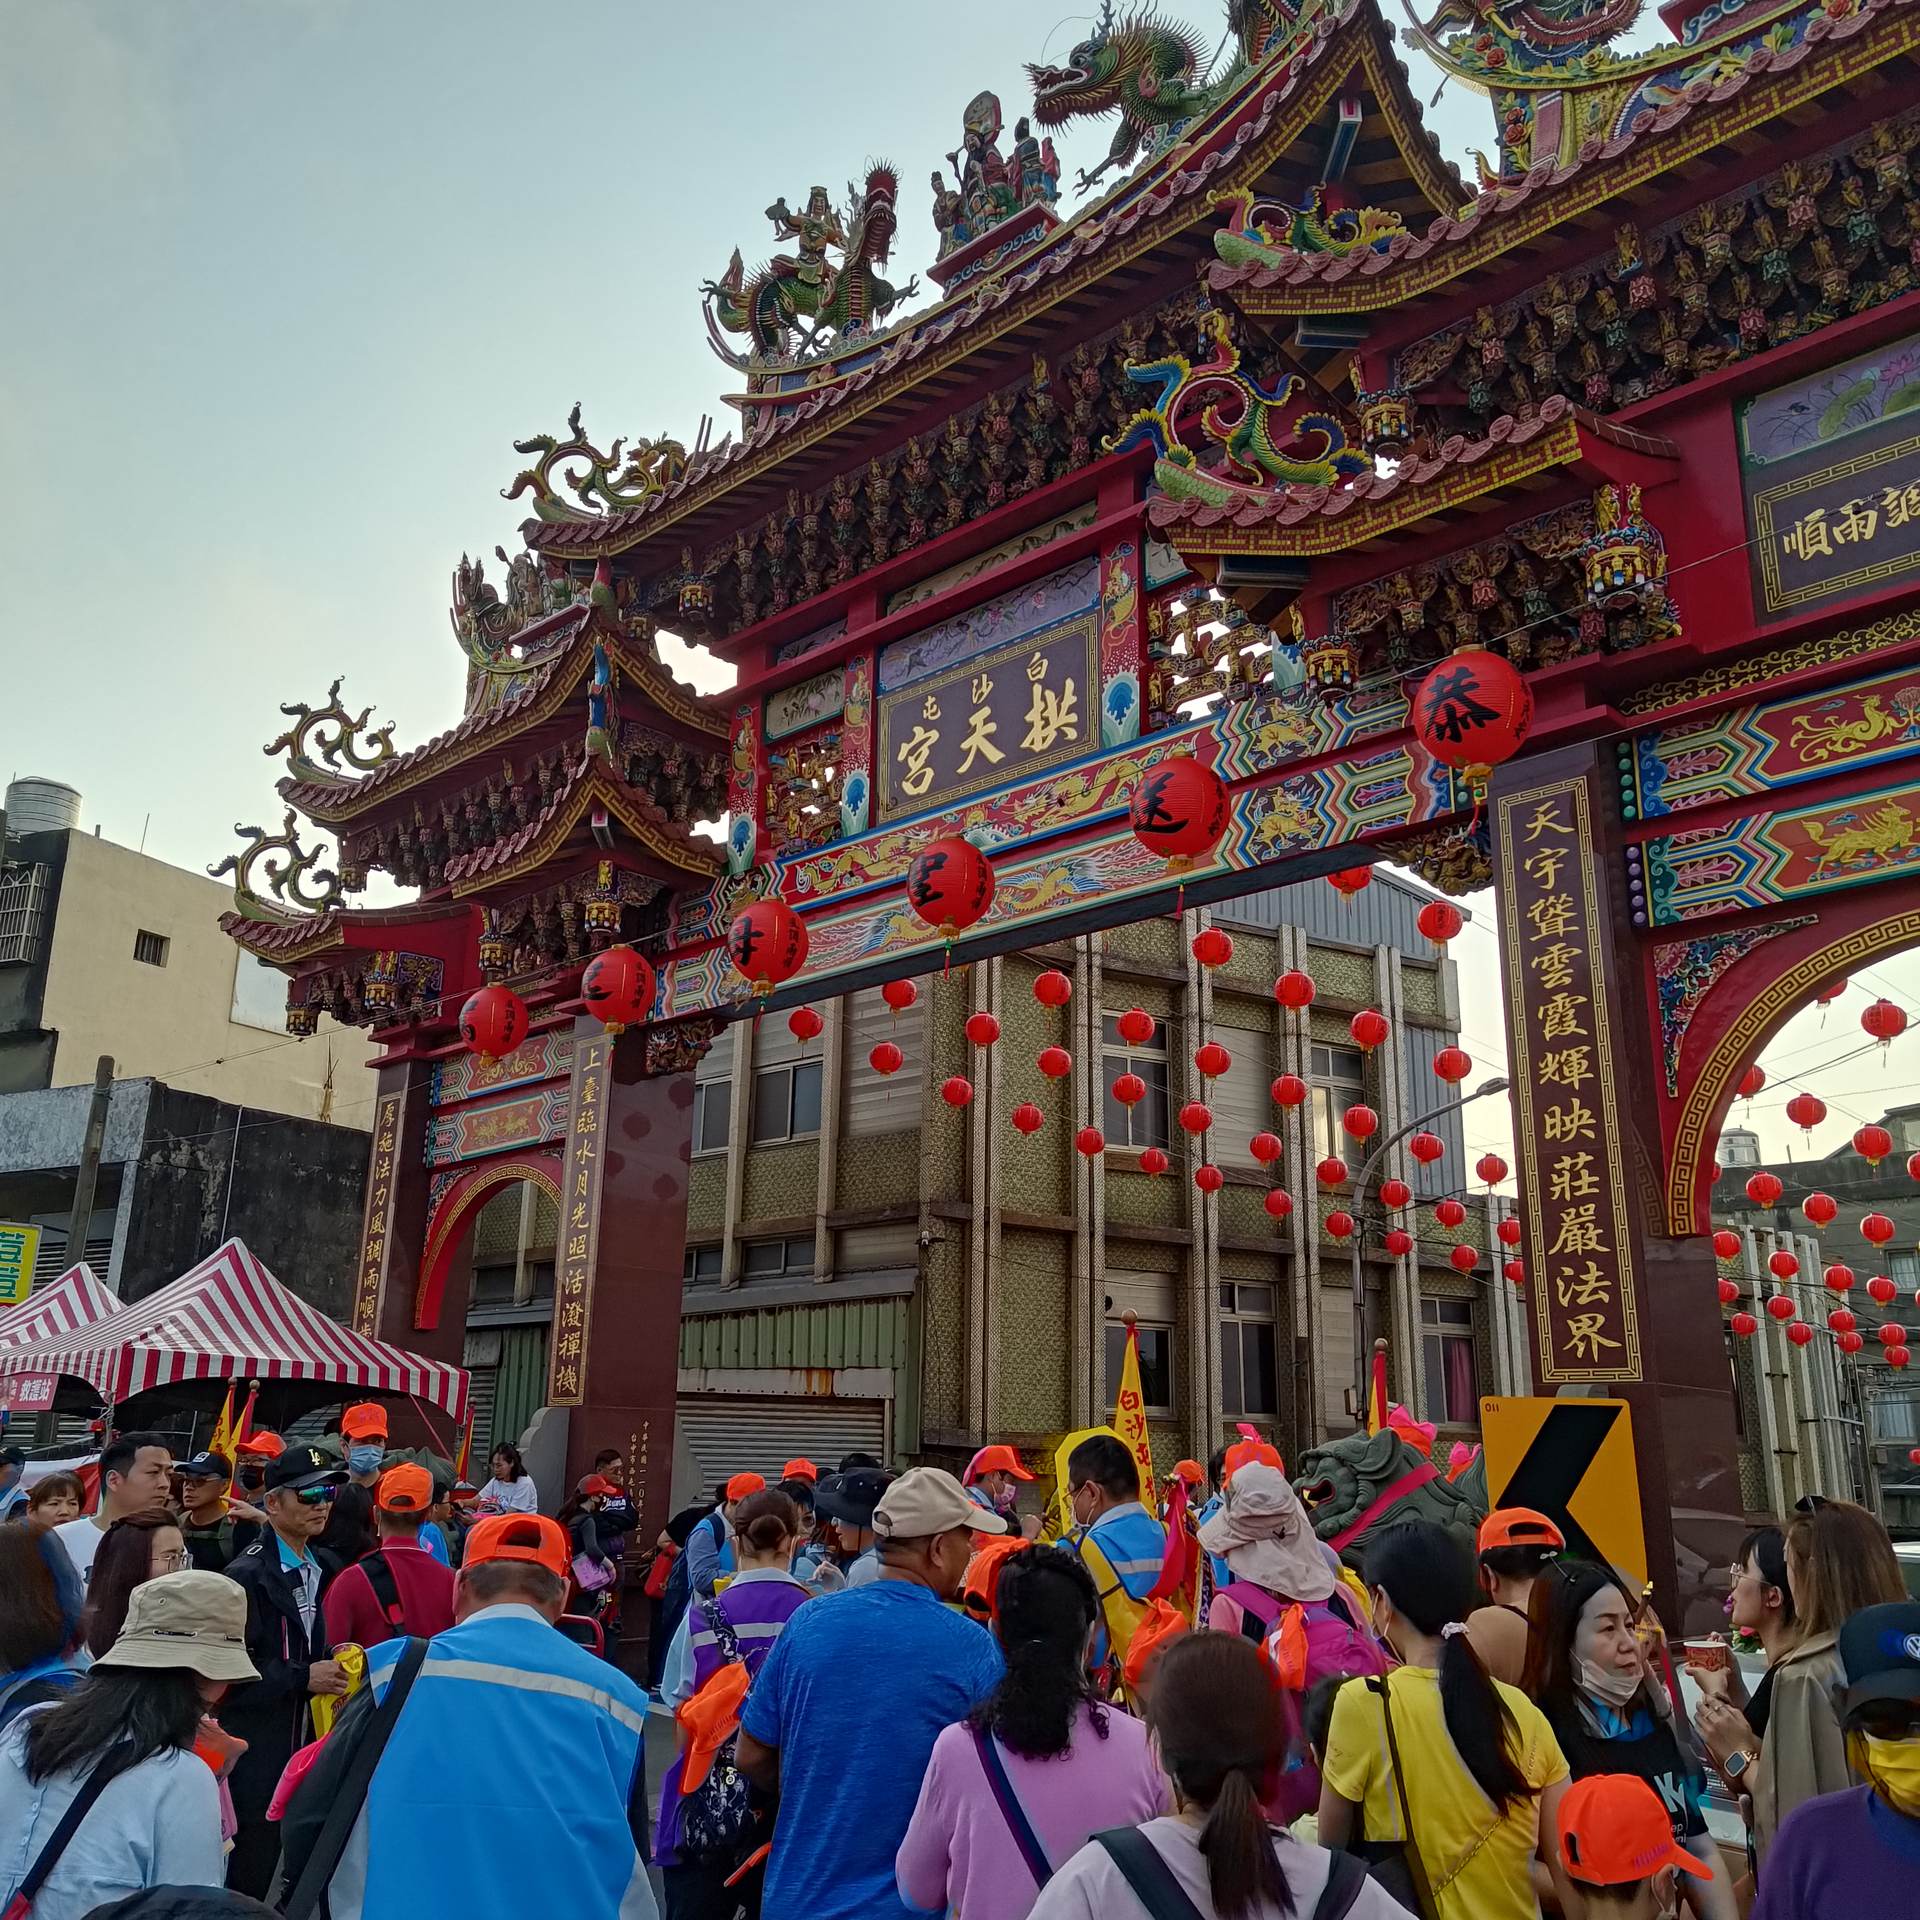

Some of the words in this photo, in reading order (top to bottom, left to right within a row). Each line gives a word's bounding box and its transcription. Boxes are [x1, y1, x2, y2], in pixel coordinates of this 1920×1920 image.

[897, 677, 1079, 797] 拱天宮
[922, 652, 1049, 720] 白沙屯
[1524, 800, 1622, 1364] 天宇聳雲霞輝映莊嚴法界
[556, 1048, 602, 1394] 上臺臨水月光照活潑禪機
